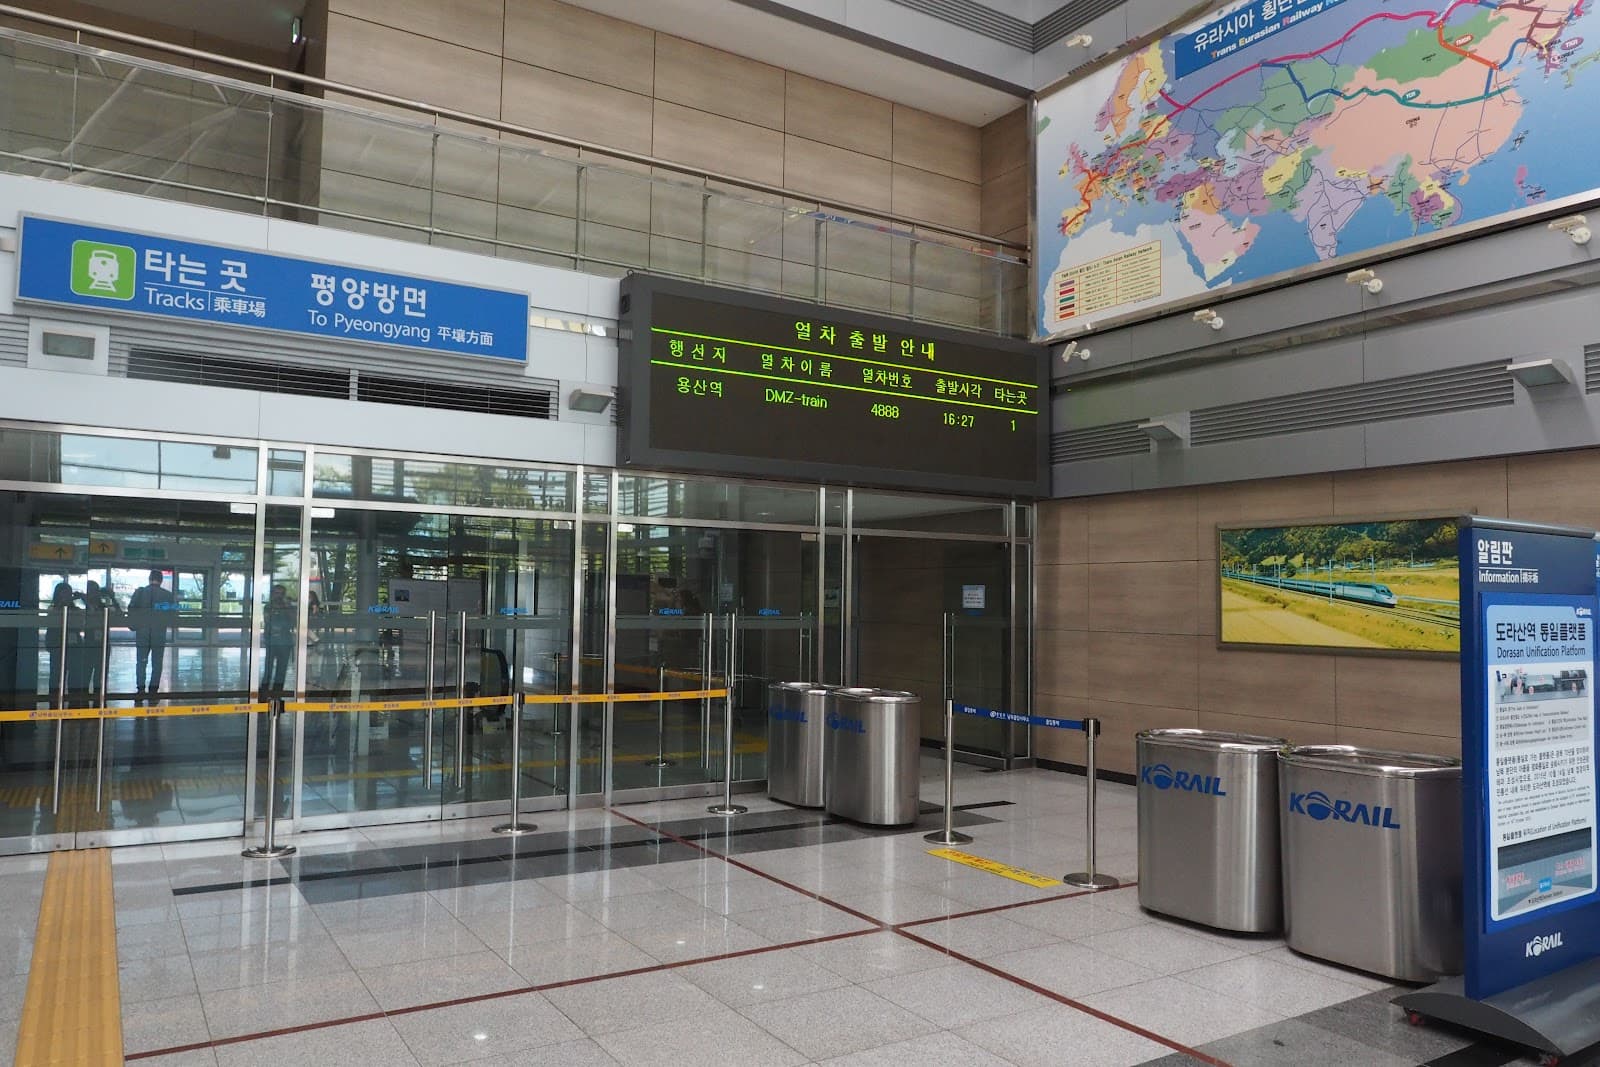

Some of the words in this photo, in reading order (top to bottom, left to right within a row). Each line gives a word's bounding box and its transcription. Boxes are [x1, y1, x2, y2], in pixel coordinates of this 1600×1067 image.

[1194, 9, 1255, 52] 유라시아
[1210, 43, 1237, 59] Trans
[1238, 22, 1281, 47] Eurasian
[1282, 1, 1323, 26] Railway
[144, 249, 207, 287] 타는
[219, 259, 248, 292] 곳
[144, 287, 204, 311] Tracks
[311, 273, 427, 318] 평양방면
[308, 309, 328, 326] To
[334, 313, 431, 342] Pyeongyang
[668, 339, 727, 363] 행선지
[862, 368, 913, 389] 열차번호
[935, 378, 983, 399] 출발시각
[994, 387, 1028, 406] 타는곳
[677, 376, 722, 398] 용산역
[765, 388, 828, 409] DMZ-train
[870, 403, 900, 419] 4888
[943, 412, 975, 428] 16:27
[1009, 419, 1017, 432] 1
[1477, 539, 1514, 565] 알림판
[1478, 570, 1520, 583] Information
[658, 607, 685, 616] KORAIL
[1496, 622, 1536, 642] 도라산역
[1497, 646, 1524, 659] Dorasan
[1526, 645, 1560, 657] Unification
[1561, 644, 1586, 656] Platform
[1141, 763, 1227, 796] KORAIL
[1288, 791, 1400, 829] KORAIL
[1525, 931, 1563, 957] KORAIL
